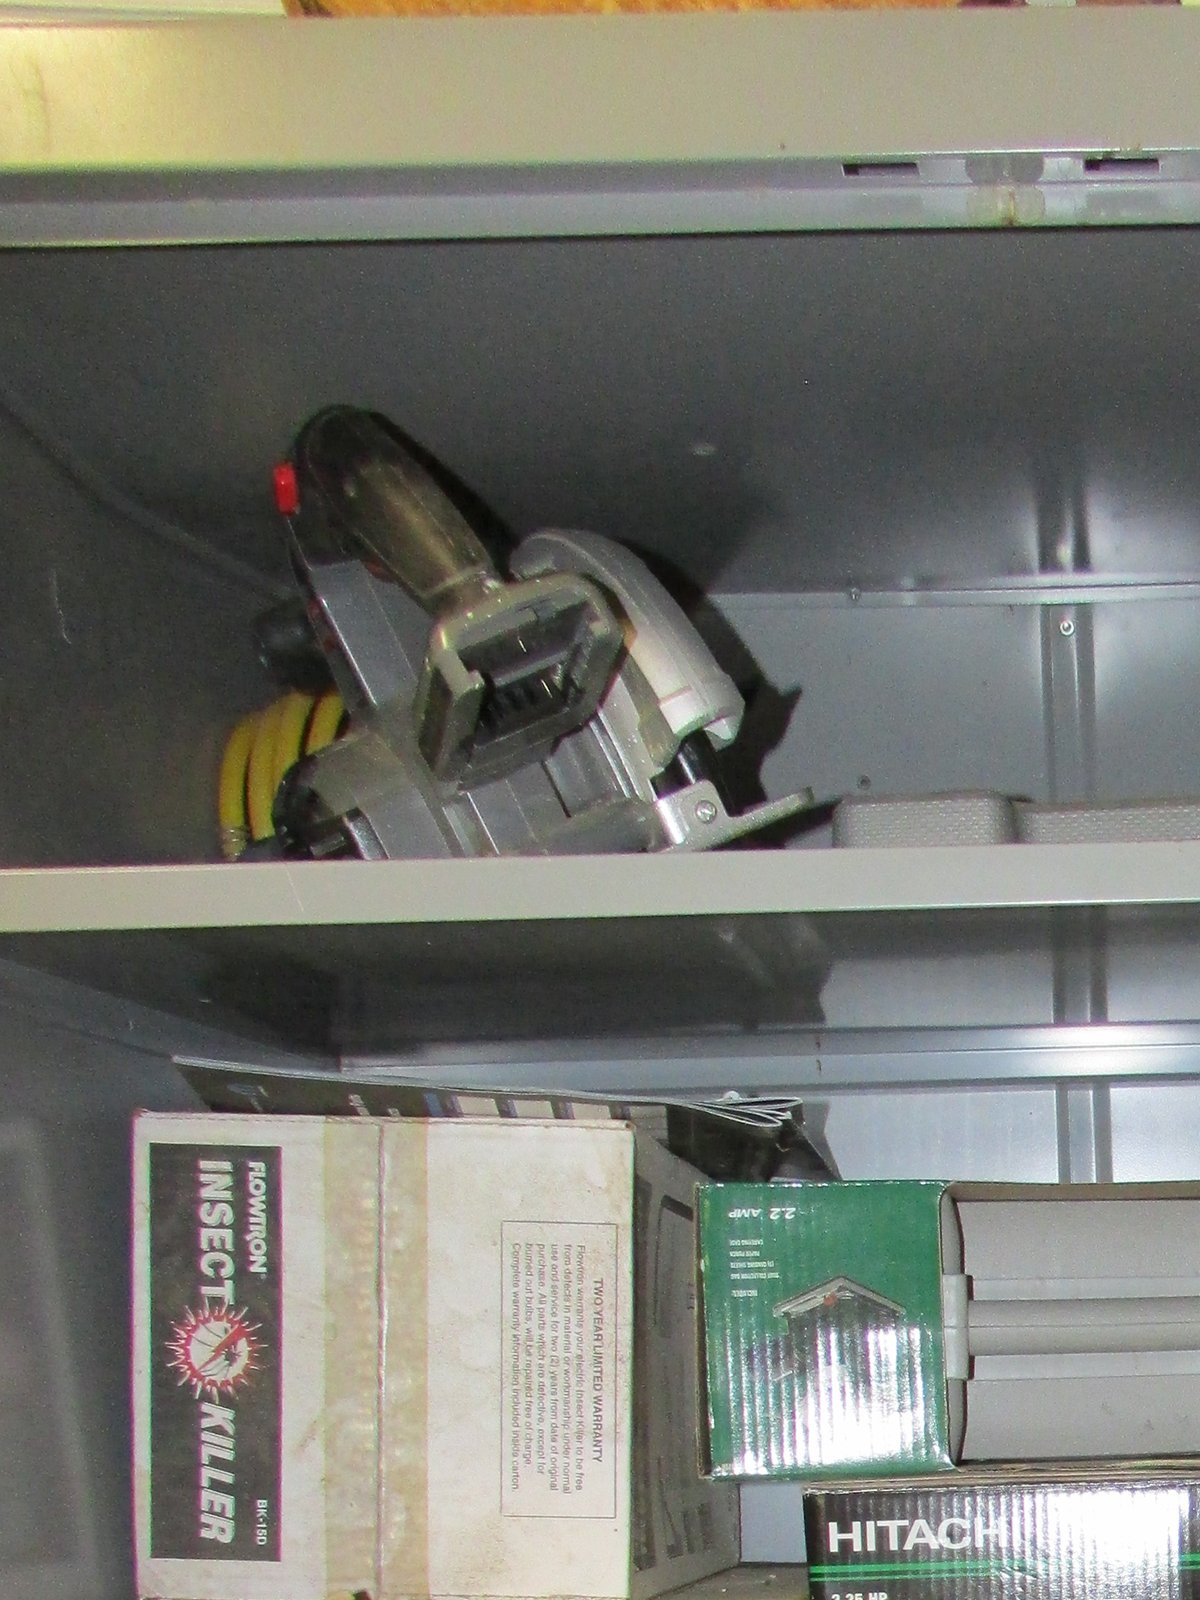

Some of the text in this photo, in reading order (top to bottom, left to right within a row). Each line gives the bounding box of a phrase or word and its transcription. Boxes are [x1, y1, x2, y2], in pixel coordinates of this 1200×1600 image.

[246, 1162, 267, 1273] FLOWTRON
[728, 1207, 796, 1219] 2.2 AMP
[564, 1244, 572, 1265] from
[576, 1245, 585, 1285] Flowtron
[551, 1264, 559, 1282] and
[564, 1268, 572, 1302] defects
[551, 1285, 559, 1317] service
[576, 1289, 585, 1328] warrants
[551, 1320, 559, 1332] for
[564, 1316, 572, 1353] material
[199, 1160, 234, 1543] INSECT KILLER
[575, 1332, 584, 1352] your
[550, 1356, 559, 1368] (2)
[564, 1356, 570, 1366] or
[576, 1354, 584, 1387] electric
[592, 1279, 603, 1462] TWO YEAR LIMITED WARRANTY
[549, 1370, 557, 1395] years
[550, 1398, 558, 1420] from
[562, 1368, 572, 1429] workmanship
[550, 1422, 558, 1443] date
[563, 1432, 571, 1458] under
[550, 1446, 558, 1454] of
[576, 1446, 584, 1456] to
[548, 1457, 558, 1490] original
[576, 1458, 584, 1470] be
[563, 1462, 571, 1494] normal
[576, 1472, 584, 1490] free
[256, 1500, 267, 1545] BK-15D
[828, 1519, 1018, 1552] HITACH
